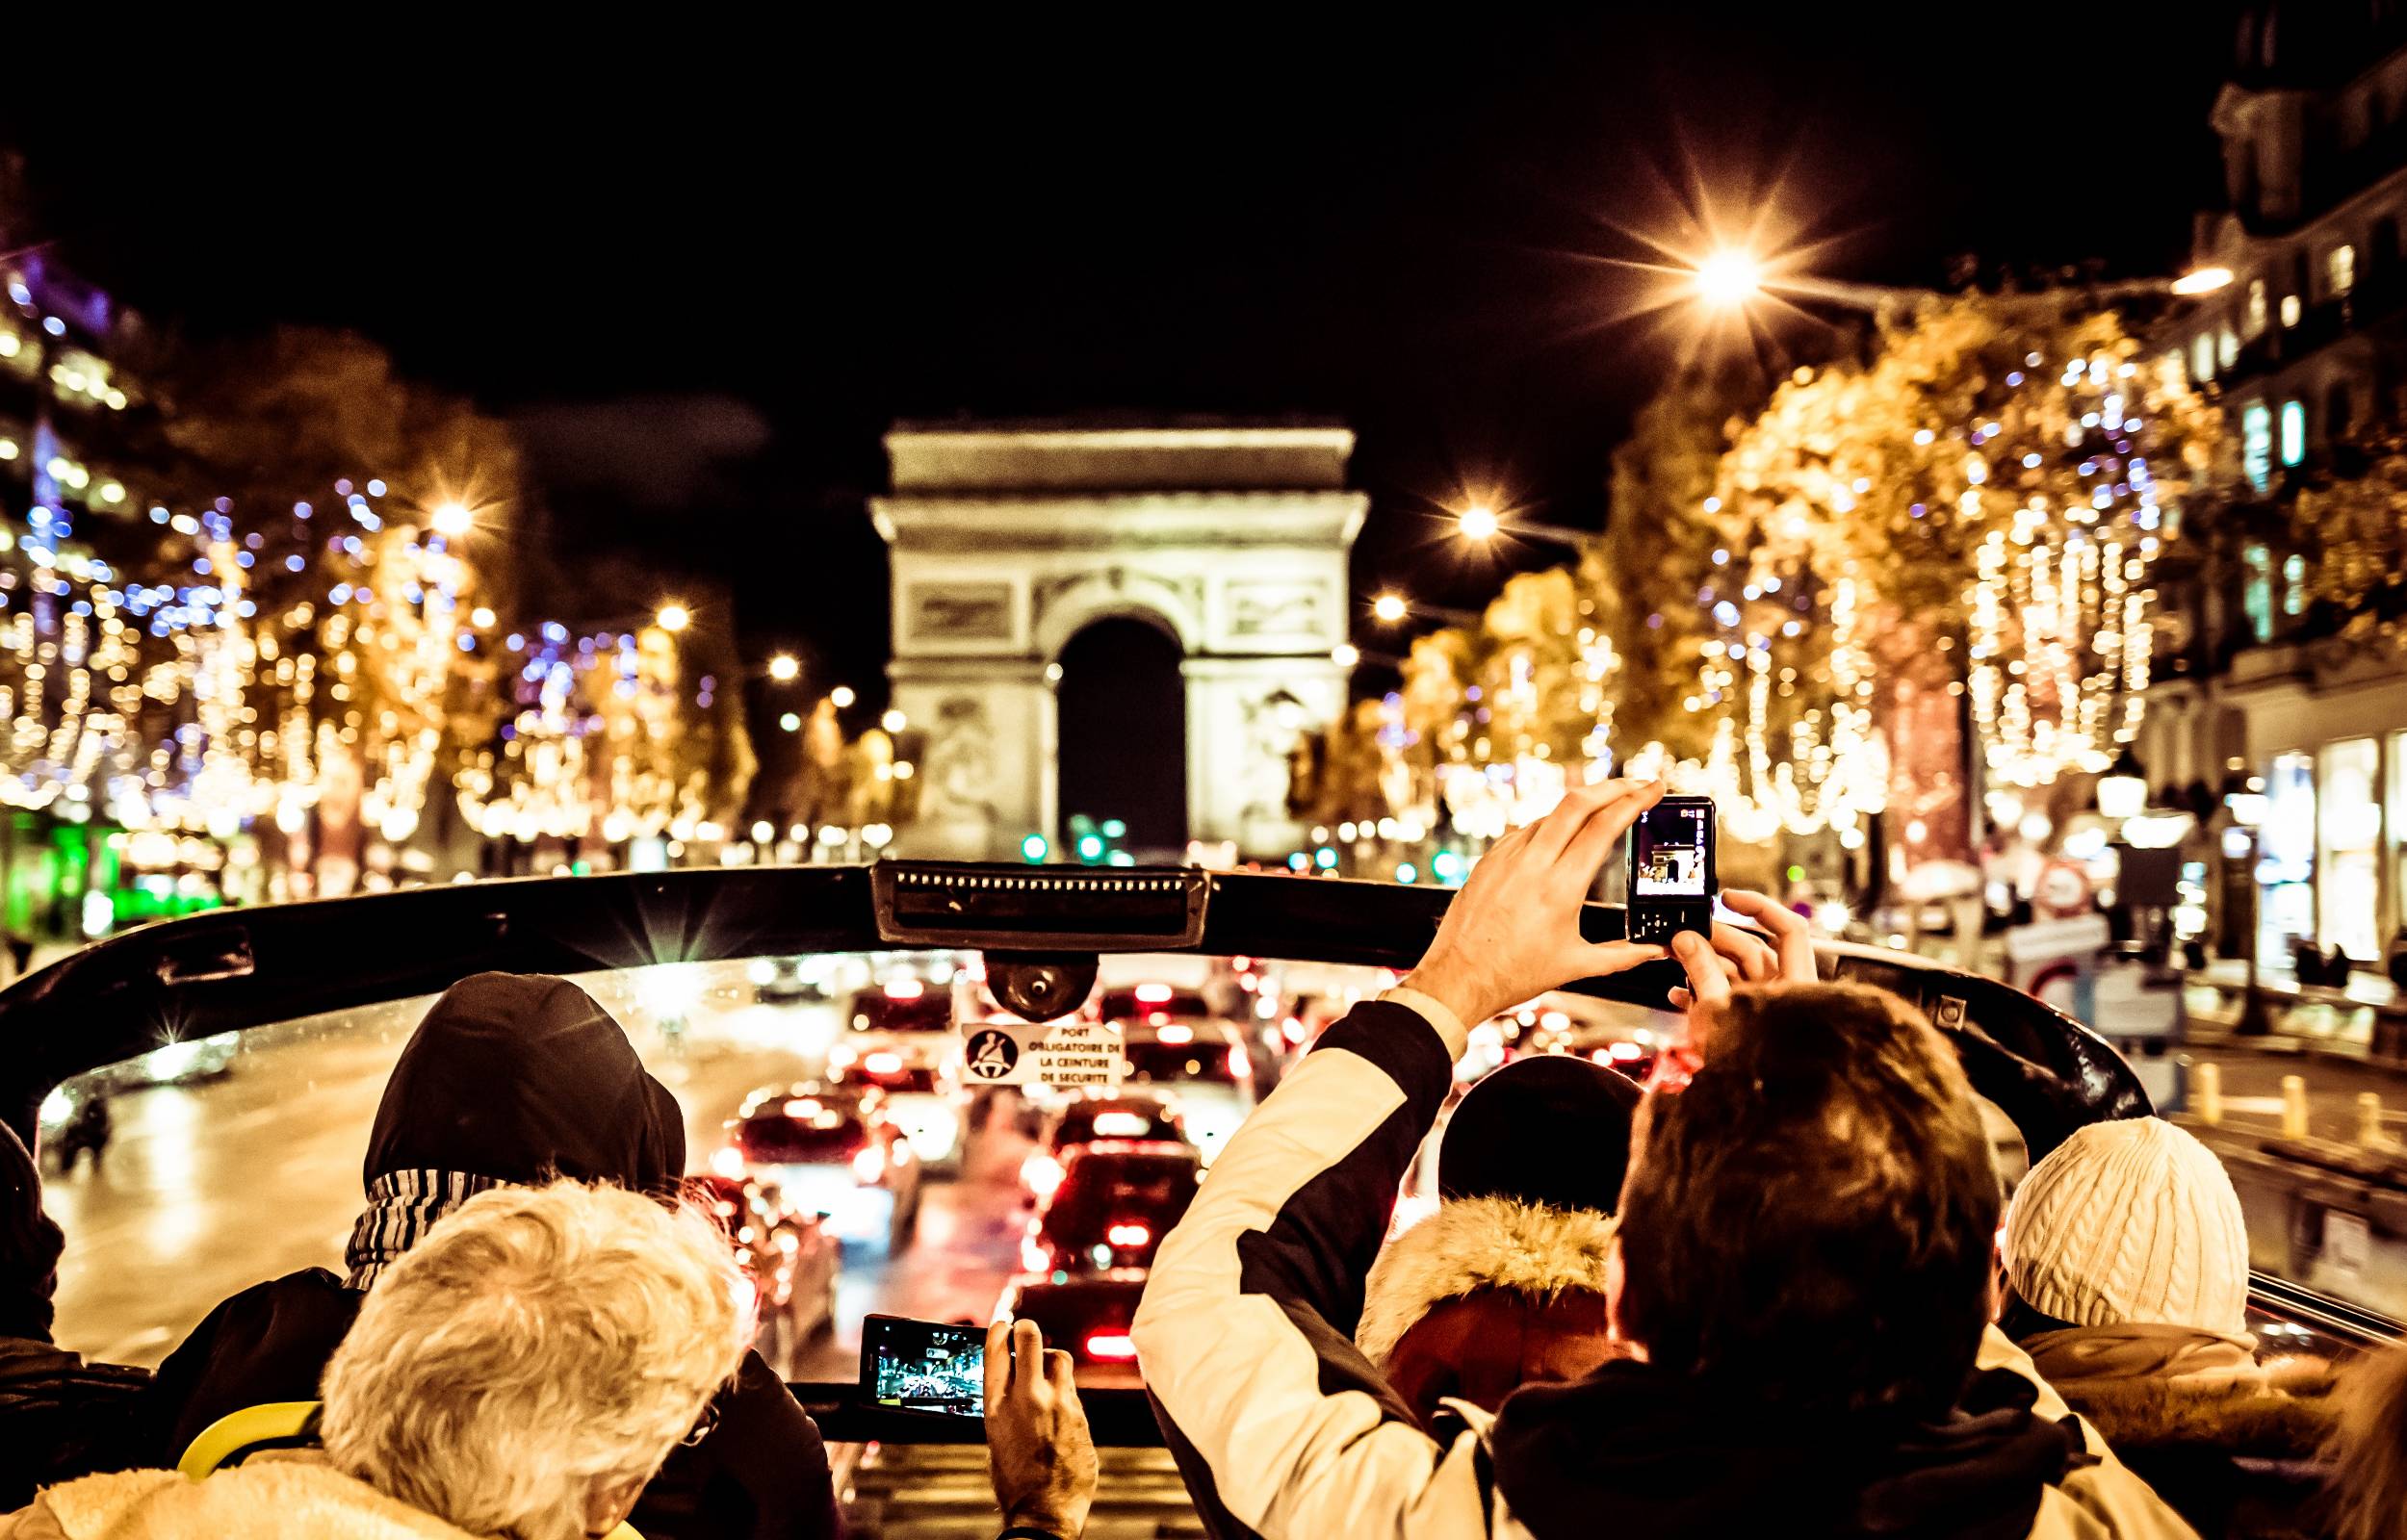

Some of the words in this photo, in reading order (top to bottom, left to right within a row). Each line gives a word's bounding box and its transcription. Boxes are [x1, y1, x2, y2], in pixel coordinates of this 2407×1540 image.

[1061, 1028, 1090, 1037] PORT
[1028, 1041, 1102, 1053] OBLIGATOIRE
[1107, 1043, 1121, 1053] DE
[1040, 1058, 1052, 1067] LA
[1057, 1058, 1109, 1067] CEINTURE
[1041, 1073, 1054, 1082] DE
[1059, 1073, 1108, 1083] SECURITE
